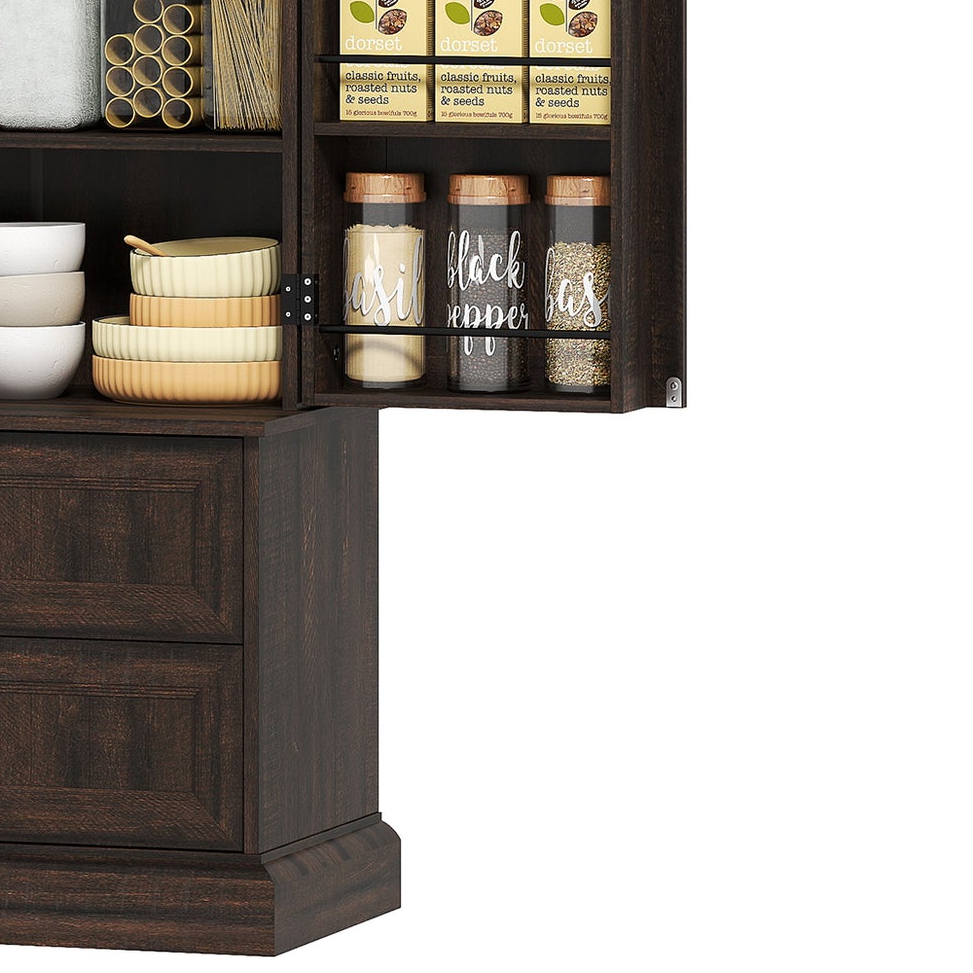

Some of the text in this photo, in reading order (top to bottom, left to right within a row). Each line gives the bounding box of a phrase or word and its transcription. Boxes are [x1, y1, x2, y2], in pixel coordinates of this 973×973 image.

[345, 36, 402, 51] dorset
[440, 37, 498, 52] dorset
[535, 38, 593, 54] dorset
[346, 71, 421, 83] classic fruits,
[441, 72, 517, 84] classic fruits,
[535, 74, 574, 83] classic
[346, 83, 417, 93] roasted nuts
[441, 85, 513, 94] roasted nuts
[536, 86, 608, 96] roasted nuts
[346, 95, 389, 104] & seeds
[441, 96, 485, 106] & seeds
[536, 97, 579, 107] & seeds
[447, 230, 526, 291] black
[342, 234, 424, 327] asil
[545, 247, 611, 328] bas
[447, 303, 529, 356] epper
